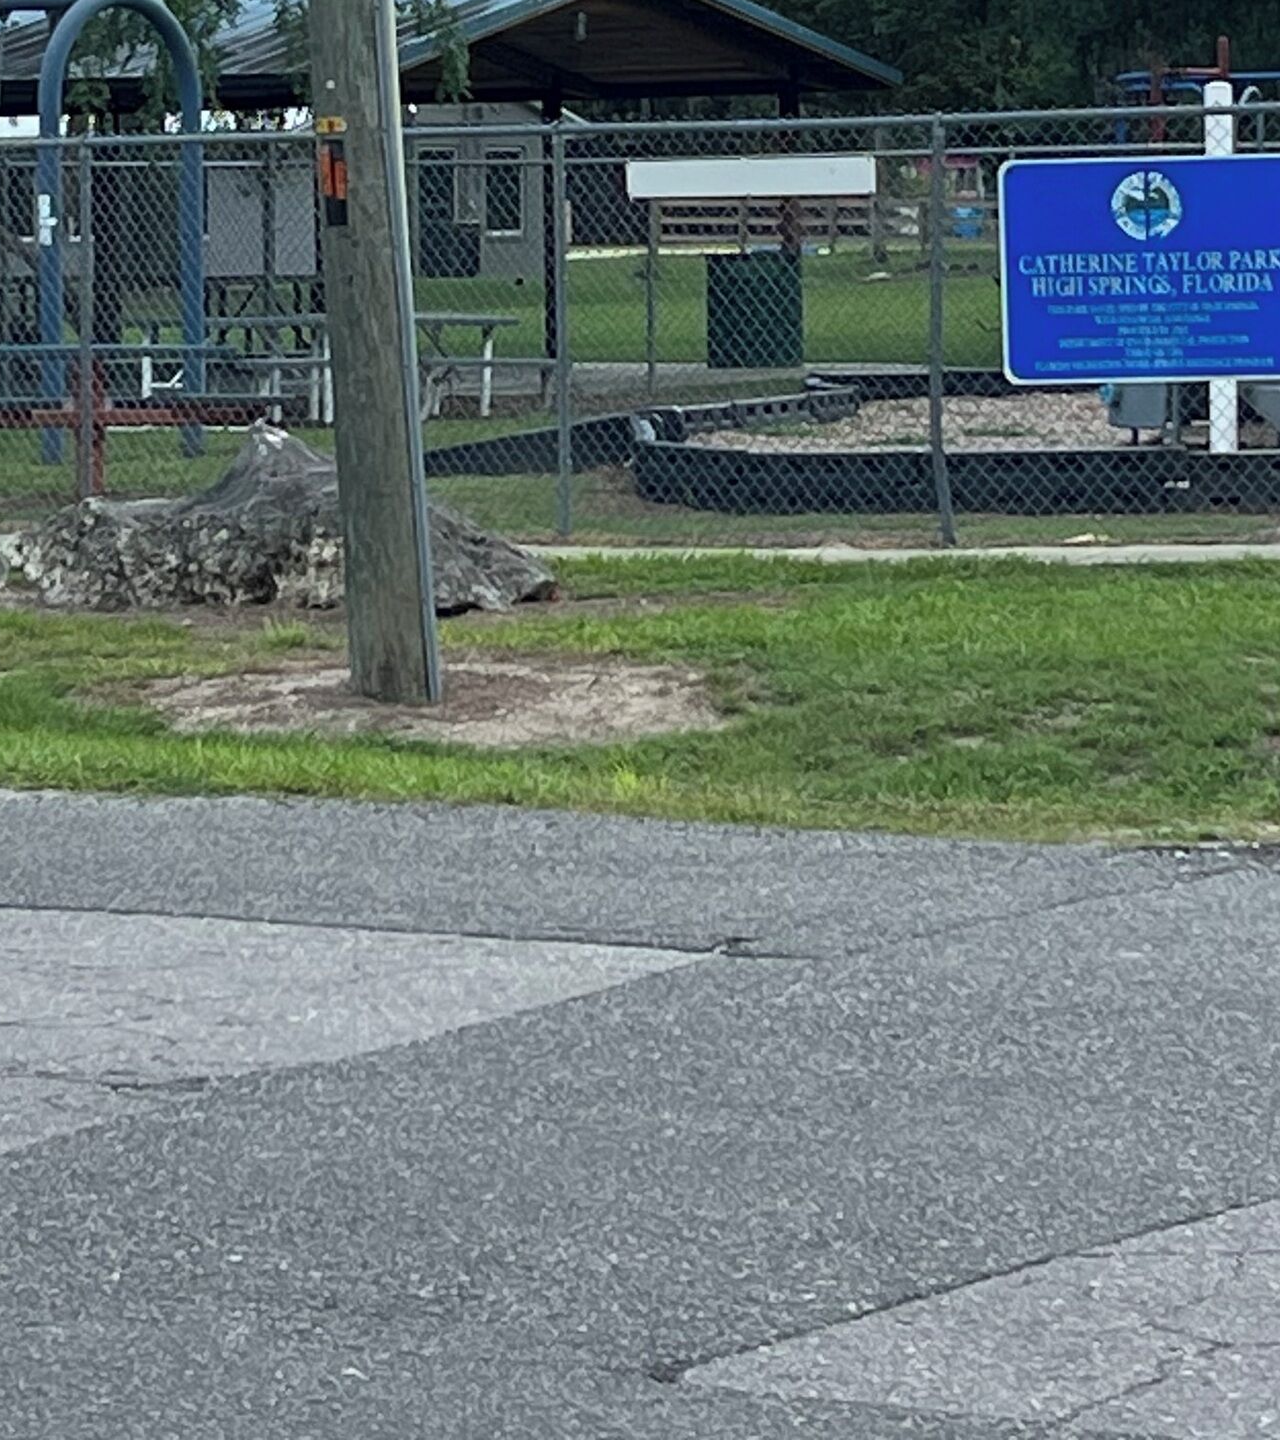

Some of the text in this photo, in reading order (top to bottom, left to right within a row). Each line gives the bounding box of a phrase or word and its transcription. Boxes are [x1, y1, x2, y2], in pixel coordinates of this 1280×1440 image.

[1019, 253, 1138, 275] CATHERINE
[1142, 251, 1223, 272] TAYLOR
[1031, 273, 1274, 298] HIGH SPRINGS, FLORIDA
